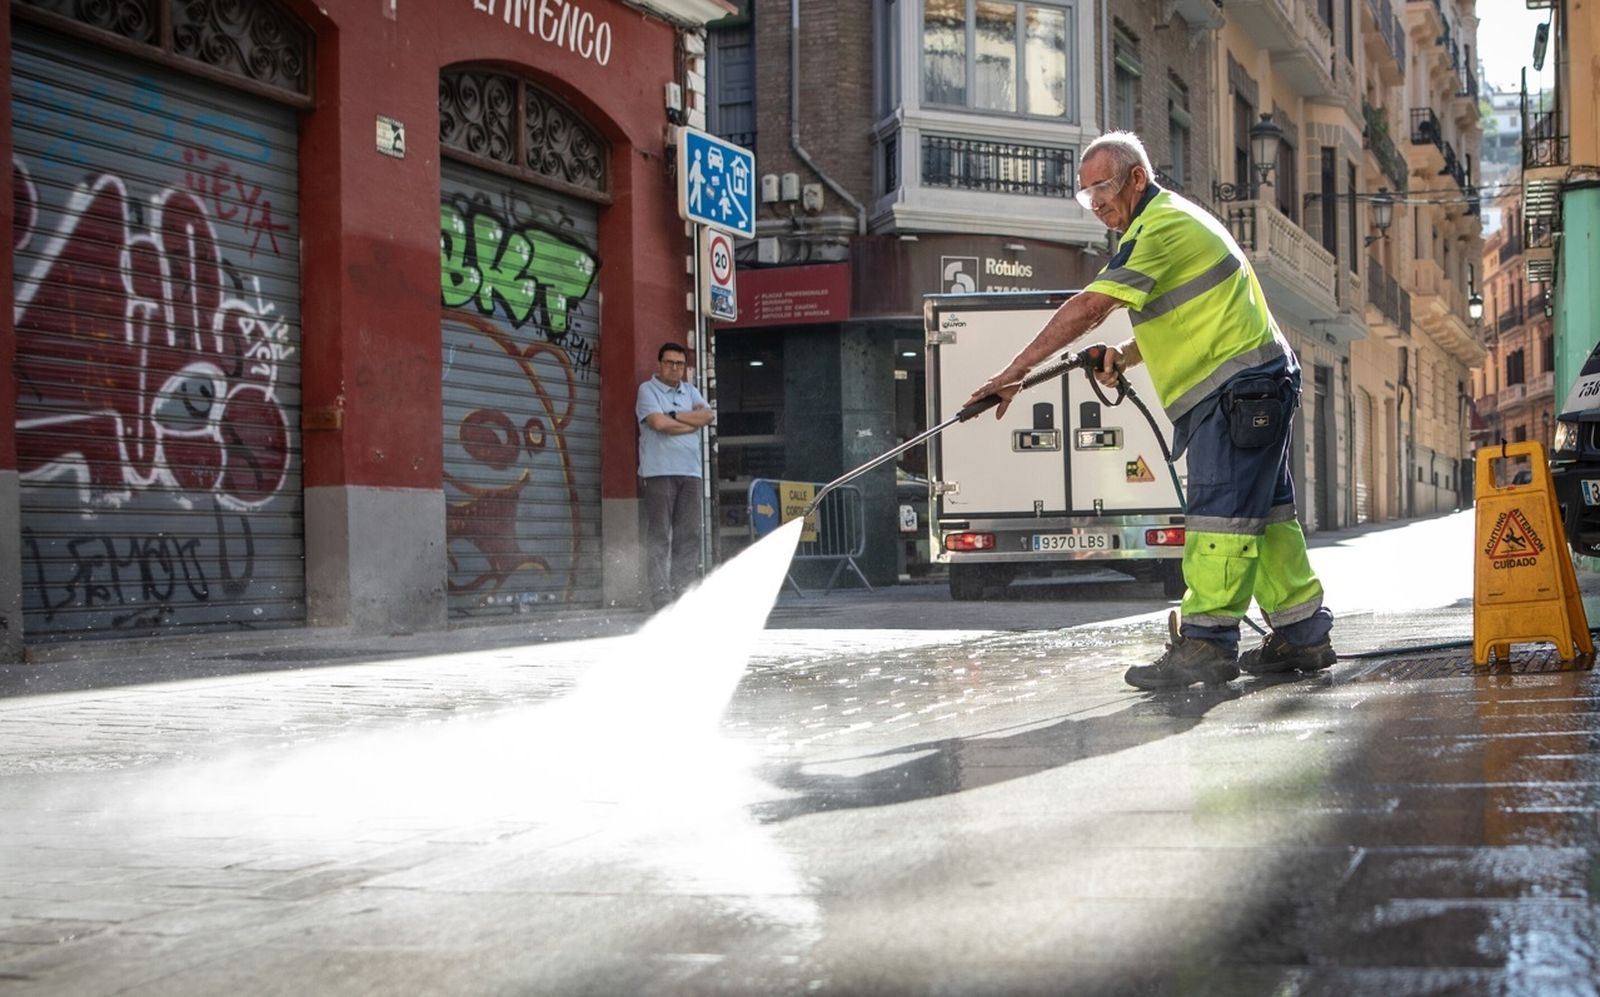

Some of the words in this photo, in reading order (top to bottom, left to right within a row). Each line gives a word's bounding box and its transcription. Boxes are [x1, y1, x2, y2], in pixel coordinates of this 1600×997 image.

[473, 0, 612, 66] MENCO
[714, 252, 728, 270] 20
[985, 258, 1033, 278] Rótulos
[789, 490, 808, 501] CALLE
[1484, 511, 1508, 556] ACHTUNG
[1512, 507, 1547, 553] ATTENTION
[1042, 536, 1076, 549] 9370
[1079, 535, 1105, 548] LBS
[1492, 557, 1537, 570] CUIDADO
